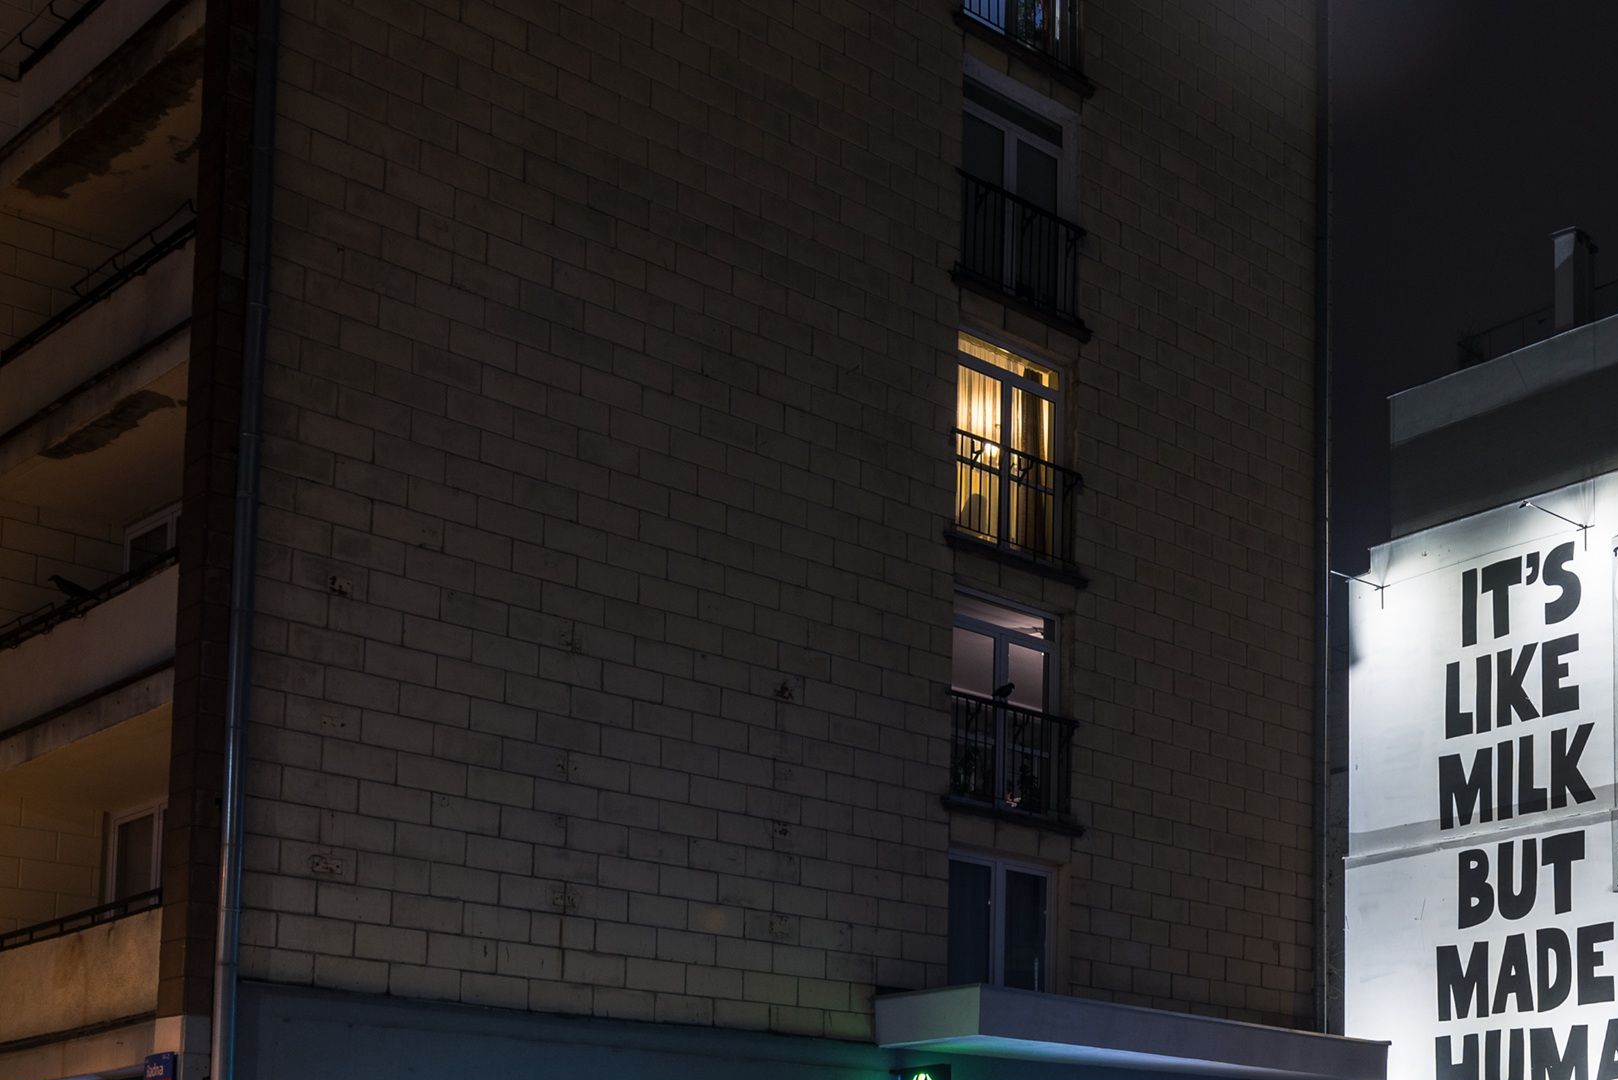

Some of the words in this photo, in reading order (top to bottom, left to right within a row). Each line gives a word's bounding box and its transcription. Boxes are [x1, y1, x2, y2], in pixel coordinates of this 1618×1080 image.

[1461, 541, 1581, 648] IT'S
[1446, 633, 1580, 740] LIKE
[1438, 722, 1596, 831] MILK
[1458, 830, 1585, 929] BUT
[1436, 921, 1615, 1022] MADE
